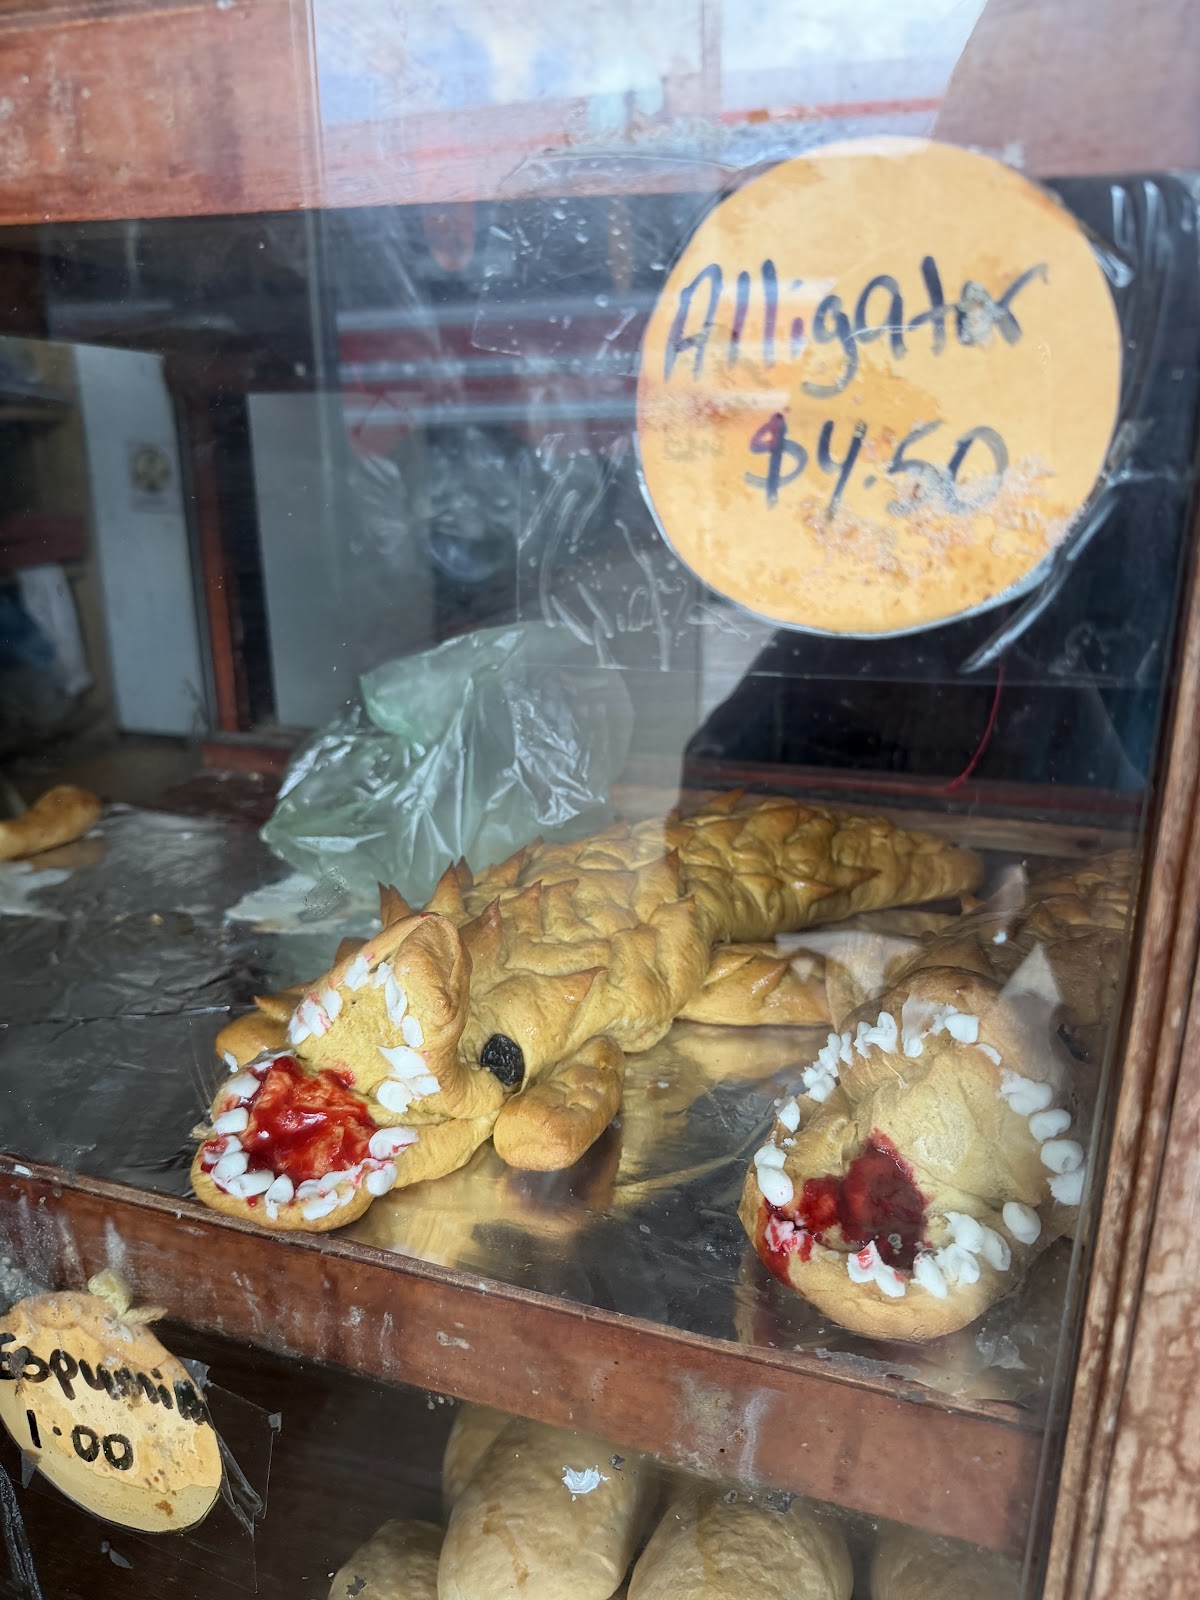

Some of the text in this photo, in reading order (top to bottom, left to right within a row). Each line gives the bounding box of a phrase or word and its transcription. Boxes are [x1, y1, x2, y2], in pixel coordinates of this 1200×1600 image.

[664, 256, 1048, 398] Alligator
[744, 412, 1009, 520] $4.50
[26, 1409, 134, 1471] 1.00
